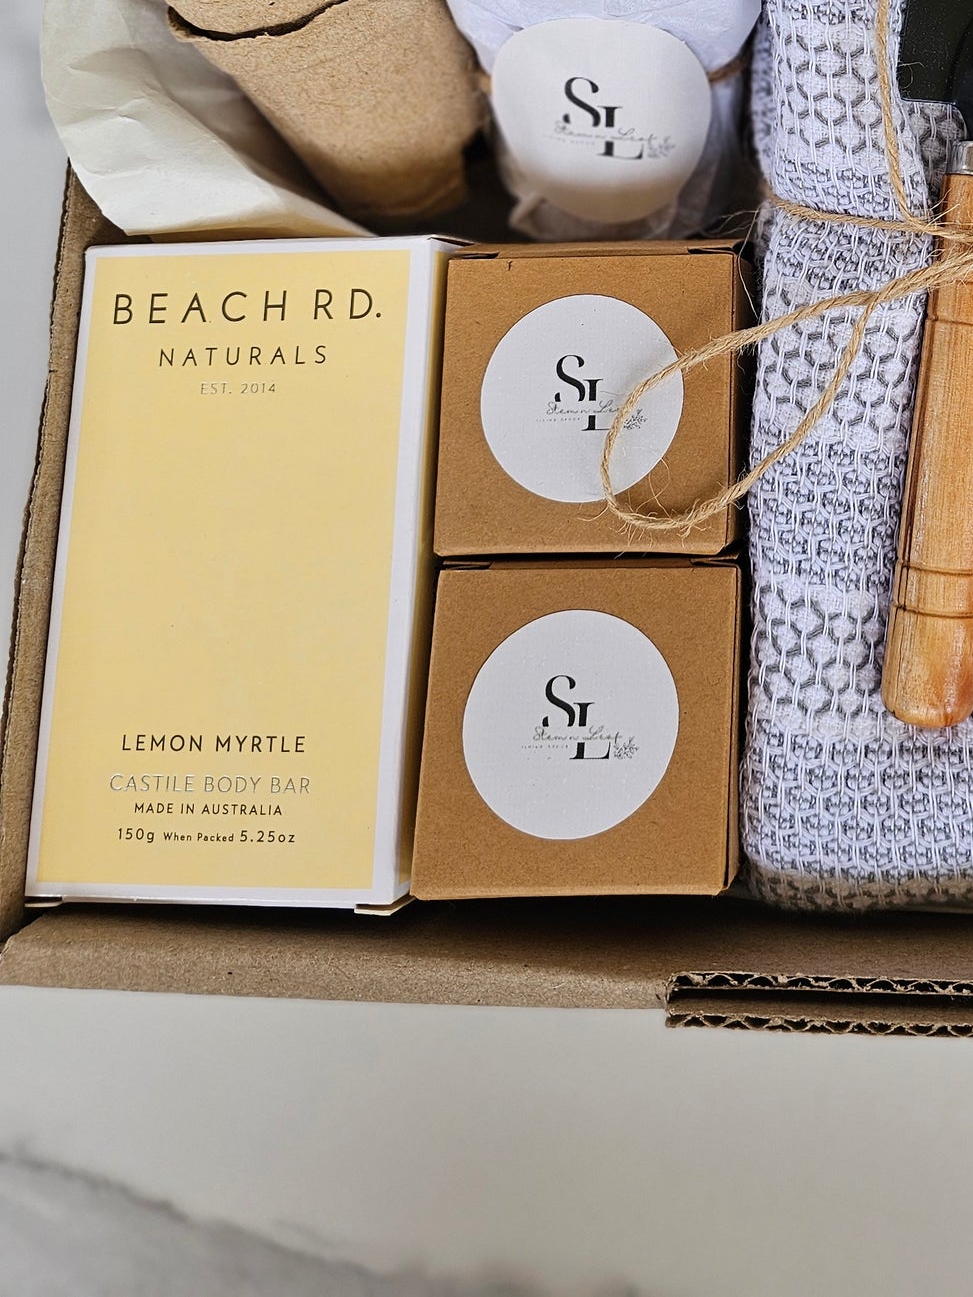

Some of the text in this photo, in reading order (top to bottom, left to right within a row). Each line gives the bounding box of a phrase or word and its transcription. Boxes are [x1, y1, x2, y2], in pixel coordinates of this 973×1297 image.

[113, 288, 382, 325] BEACH RD.
[159, 345, 328, 367] NATURALS
[200, 381, 277, 395] EST. 2014
[121, 734, 306, 753] LEMON MYRTLE
[109, 773, 311, 794] CASTILE BODY BAR
[134, 803, 283, 816] MADE IN AUSTRALIA
[117, 828, 296, 844] 150g When Packed 5.25oz
